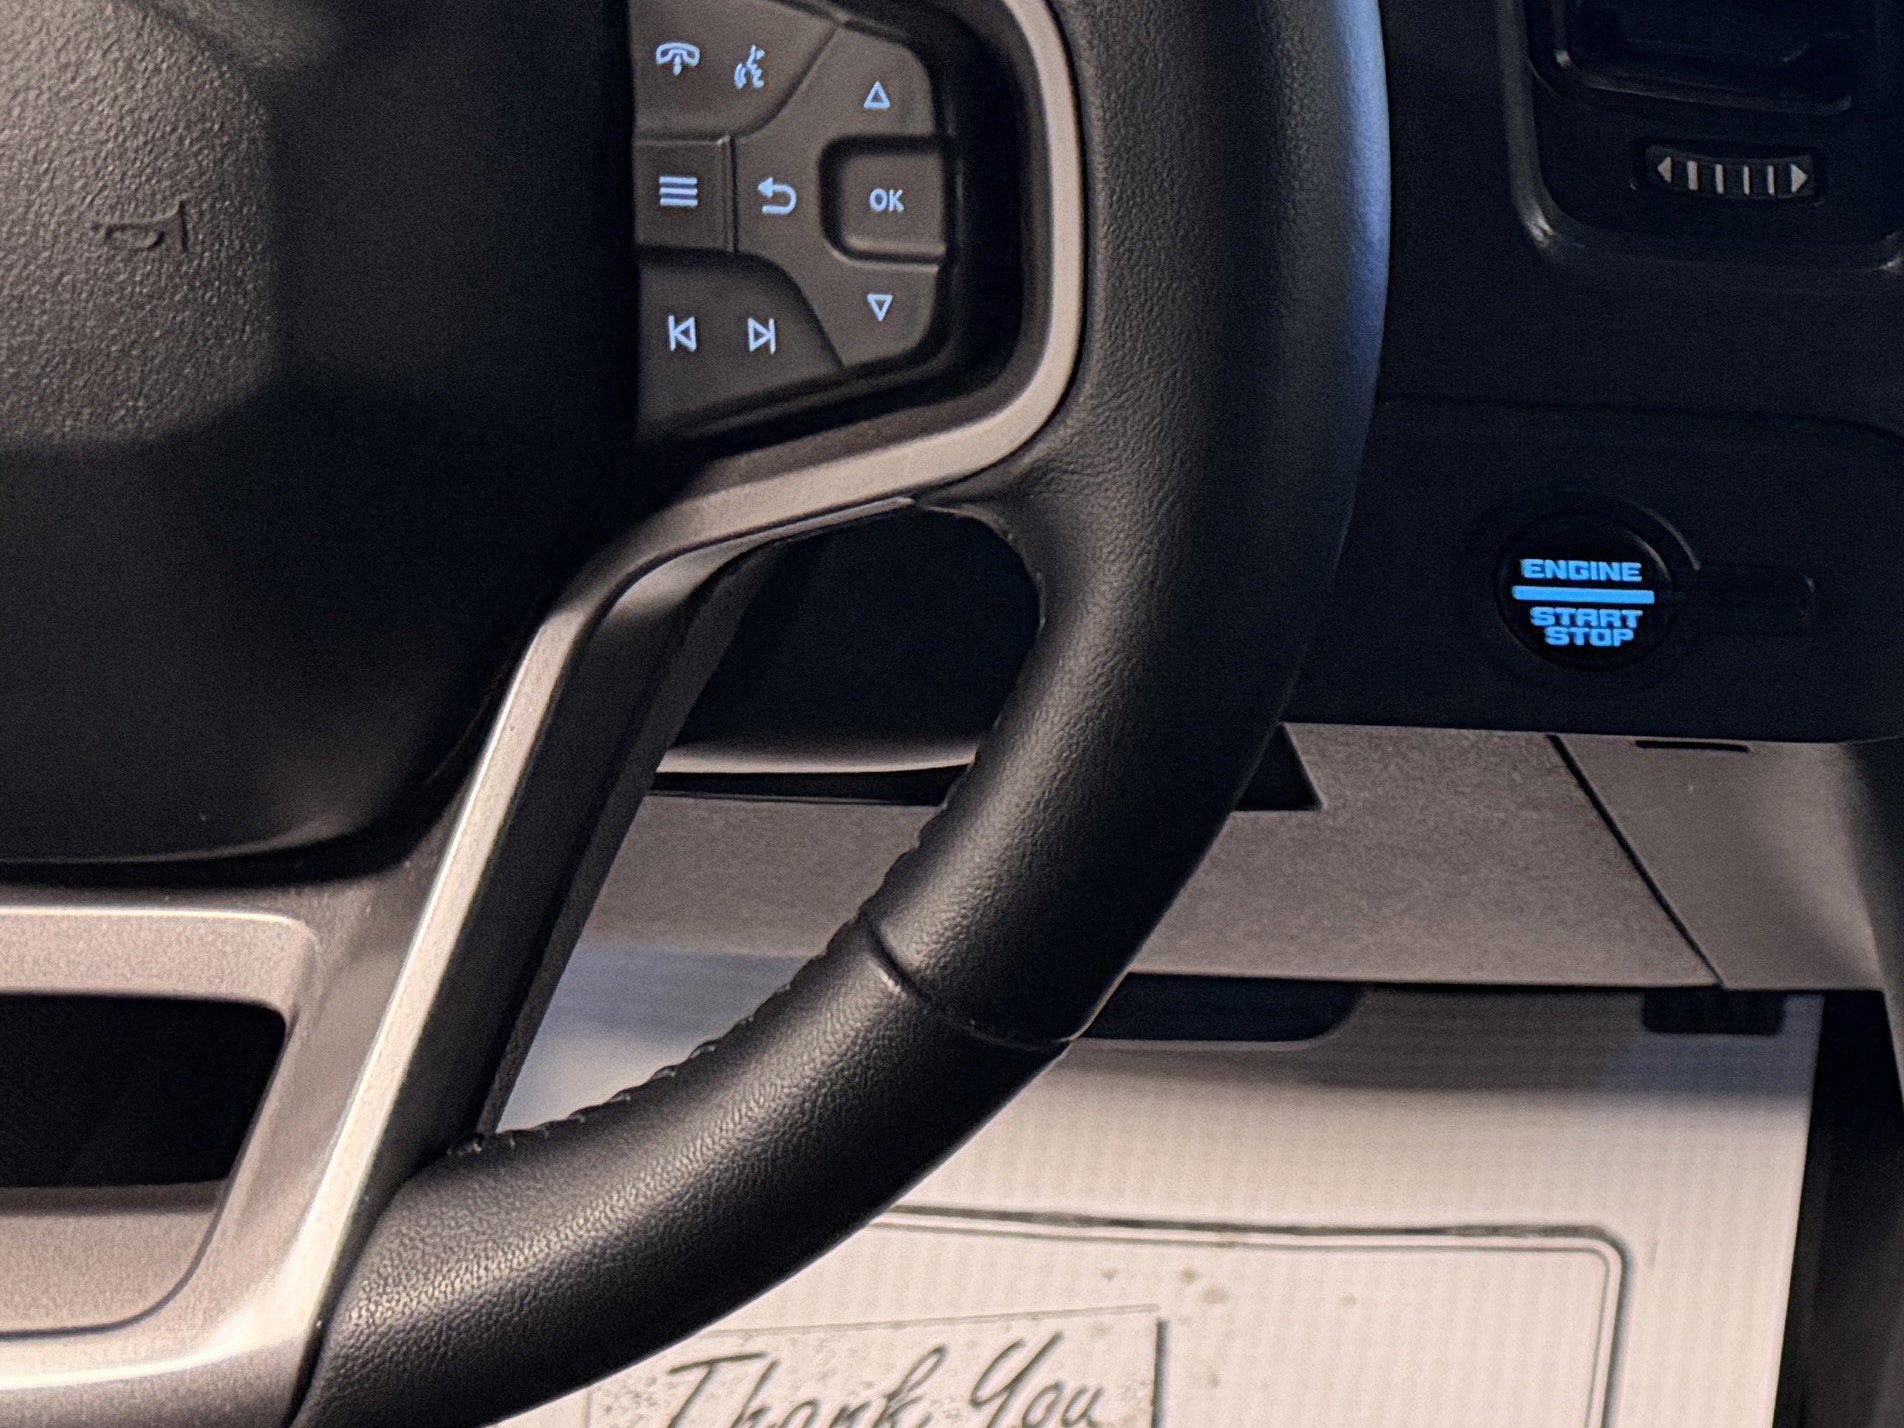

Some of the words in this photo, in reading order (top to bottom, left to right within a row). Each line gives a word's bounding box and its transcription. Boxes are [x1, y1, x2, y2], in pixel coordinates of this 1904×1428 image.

[869, 188, 905, 212] OK
[1520, 558, 1643, 582] ENGINE
[1530, 607, 1643, 628] START
[1544, 626, 1635, 647] STOP
